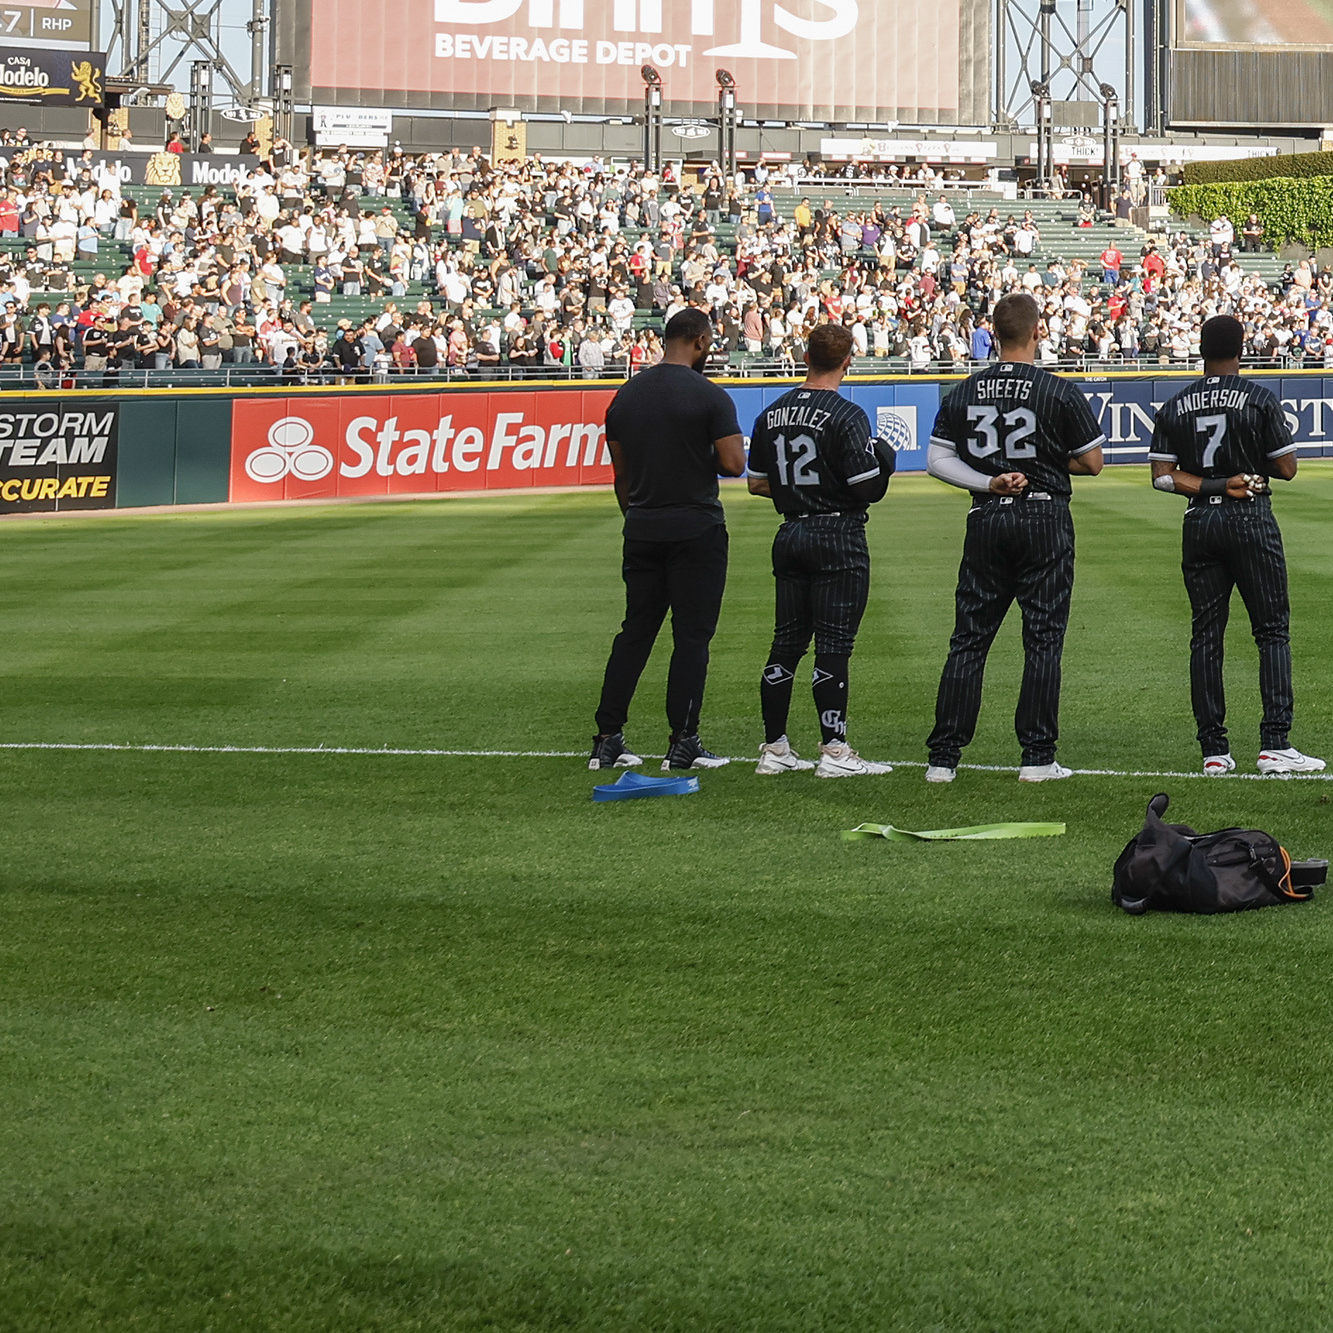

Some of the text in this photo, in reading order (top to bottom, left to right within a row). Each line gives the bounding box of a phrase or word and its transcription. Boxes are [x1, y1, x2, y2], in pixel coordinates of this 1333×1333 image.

[0, 10, 73, 33] 7 RHP
[7, 57, 31, 67] CASA
[434, 32, 692, 67] BEVERAGE DEPOT
[0, 63, 50, 88] odelo
[976, 379, 1034, 401] SHEETS
[1176, 388, 1249, 417] ANDERSON
[0, 412, 115, 438] STORM
[766, 406, 832, 432] GONZALEZ
[340, 411, 613, 478] State Farm
[966, 405, 1038, 460] 32
[1196, 413, 1228, 468] 7
[773, 433, 820, 486] 12
[0, 476, 111, 501] CURATE
